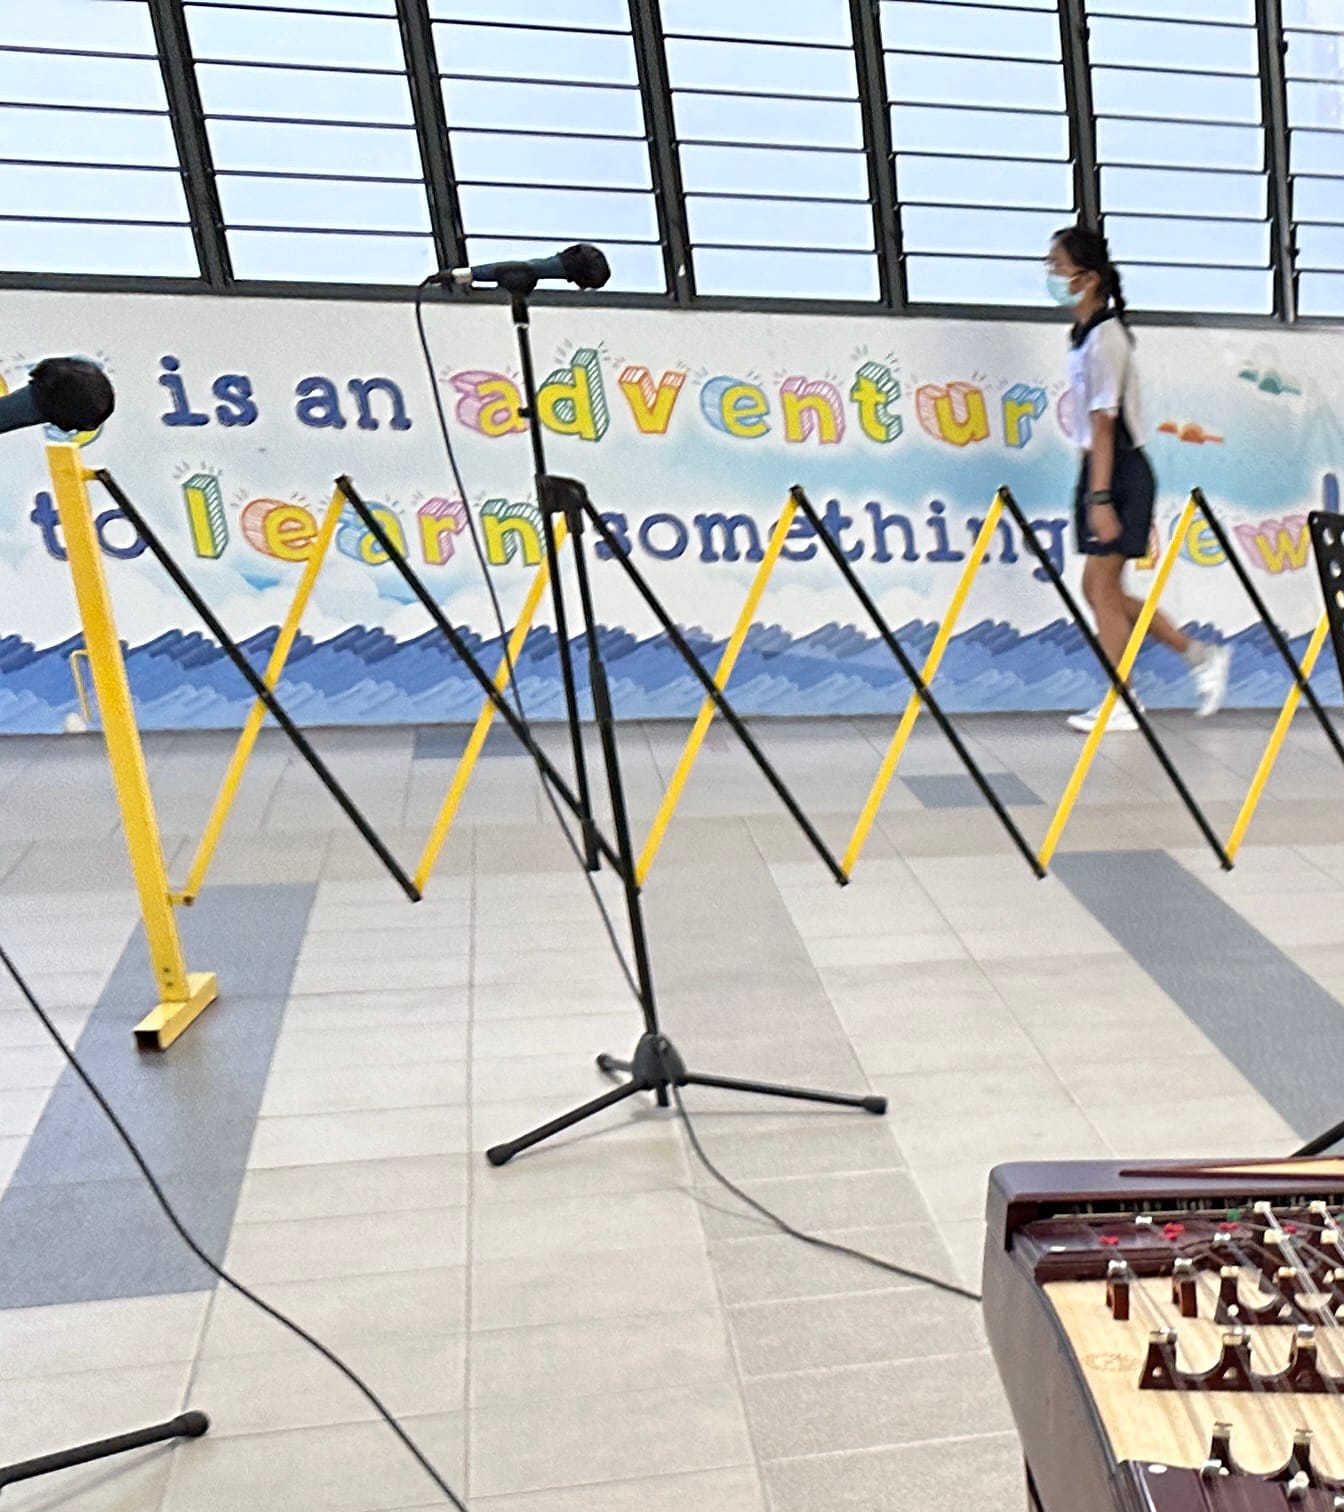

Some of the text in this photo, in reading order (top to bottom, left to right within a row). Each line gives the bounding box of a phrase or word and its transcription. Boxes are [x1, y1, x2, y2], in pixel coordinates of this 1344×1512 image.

[159, 355, 258, 427] is
[295, 375, 412, 432] an
[450, 347, 1074, 449] adventur
[31, 491, 149, 561] to
[182, 473, 547, 567] learn
[599, 499, 1068, 583] something
